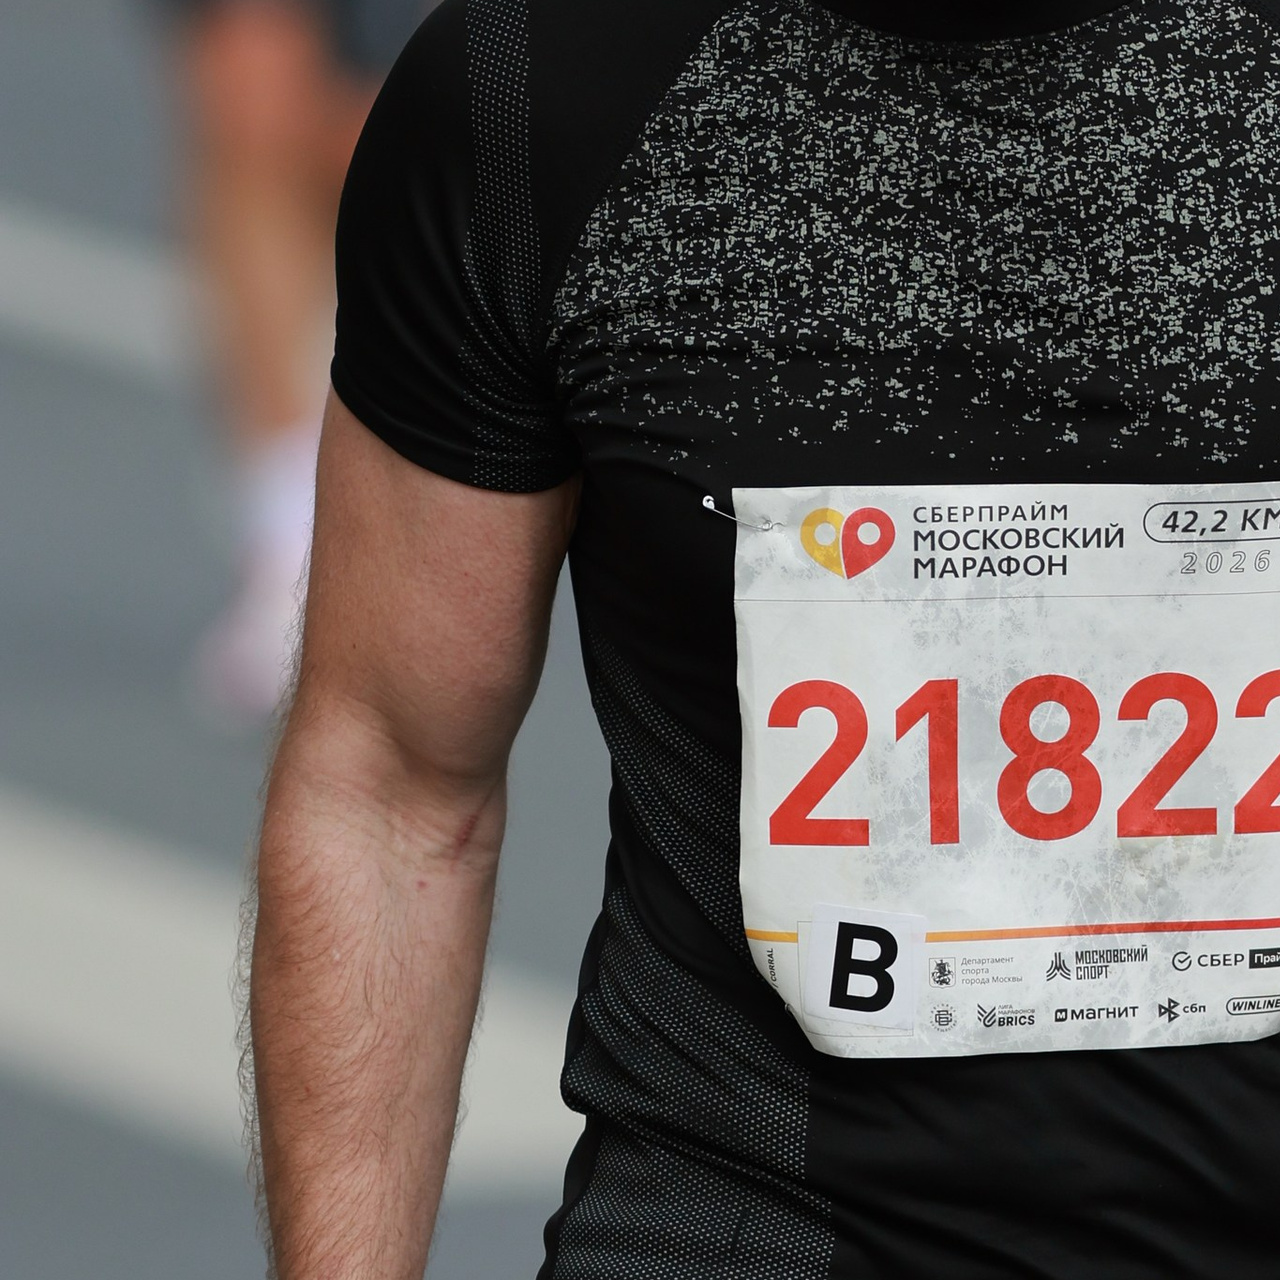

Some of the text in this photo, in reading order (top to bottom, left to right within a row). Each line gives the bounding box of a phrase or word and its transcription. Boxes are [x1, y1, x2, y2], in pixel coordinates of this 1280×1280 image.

[913, 501, 1068, 523] СБЕРПРАЙМ
[1161, 509, 1228, 536] 42,2
[913, 522, 1124, 552] МОСКОВСКИЙ
[913, 554, 1068, 579] МАРАФОН
[1180, 550, 1271, 574] 2026
[960, 956, 1015, 967] Департамент
[1075, 944, 1149, 965] МОСКОВСКИЙ
[1197, 953, 1245, 967] СБЕР
[766, 947, 777, 982] CORRAL
[960, 967, 990, 976] спорта
[1075, 964, 1110, 981] СПОРТ
[961, 974, 1024, 986] города Москвы
[1070, 1005, 1139, 1021] магнит
[1182, 1003, 1207, 1015] сбп
[997, 1014, 1036, 1027] BRICS
